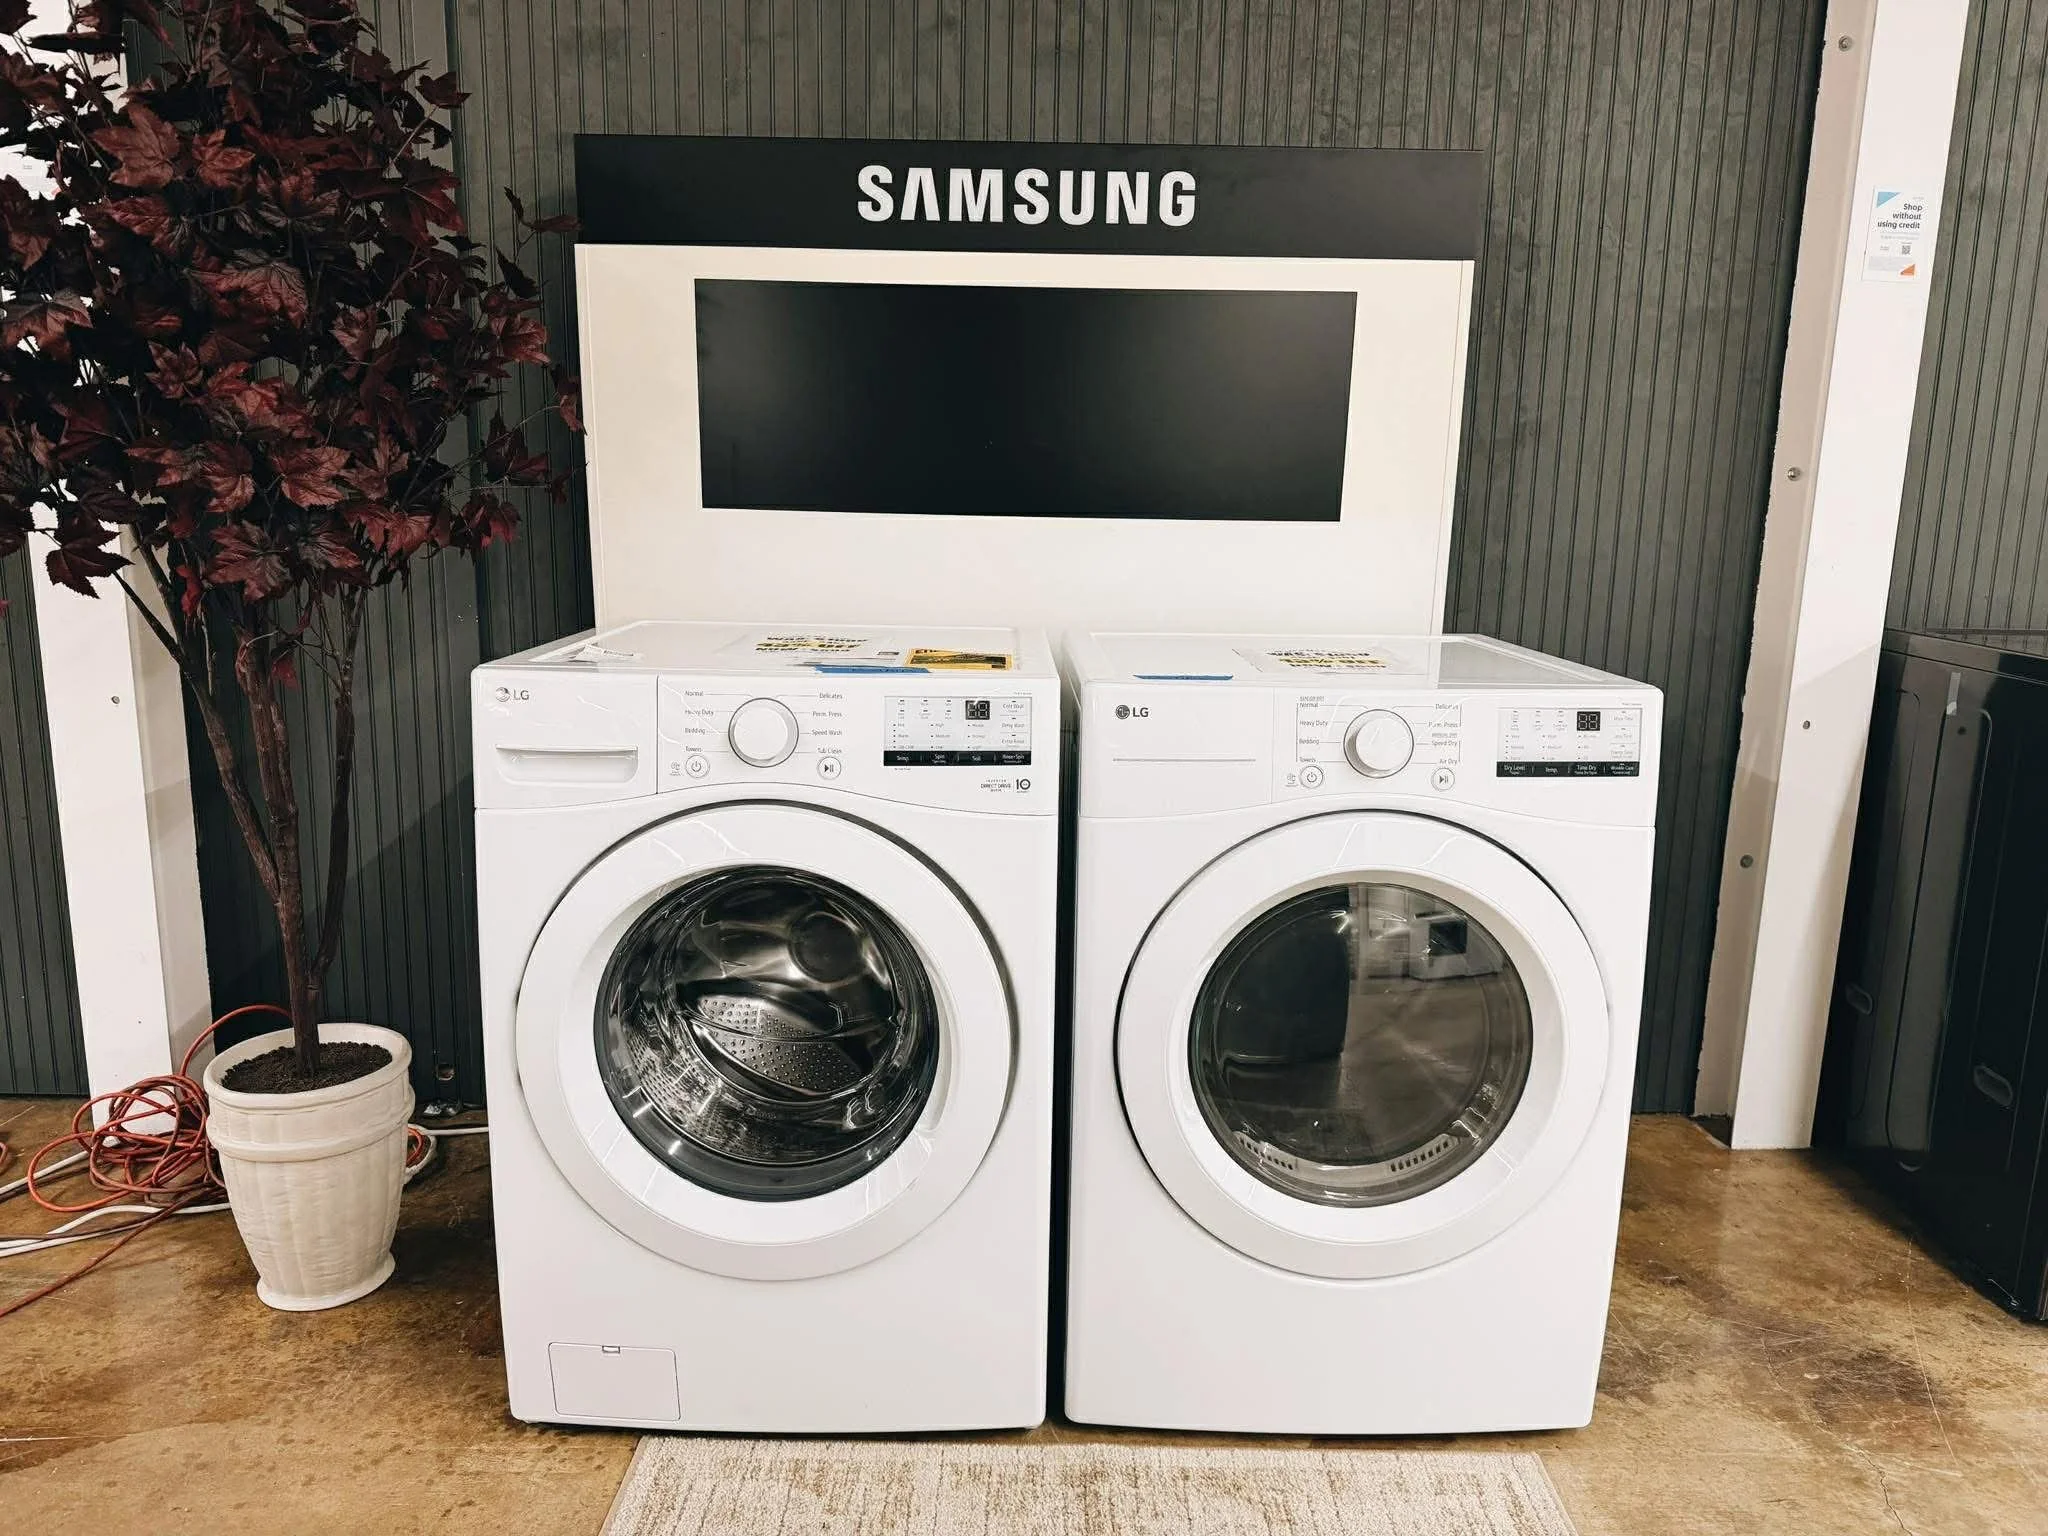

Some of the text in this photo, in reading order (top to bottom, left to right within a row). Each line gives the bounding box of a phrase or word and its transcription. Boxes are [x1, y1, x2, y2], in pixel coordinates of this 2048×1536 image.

[857, 165, 1196, 227] SAMSUNG
[1903, 203, 1923, 212] Shop
[1892, 212, 1922, 220] without
[1877, 220, 1920, 229] using credit
[513, 689, 529, 700] LG
[1132, 707, 1149, 717] LG
